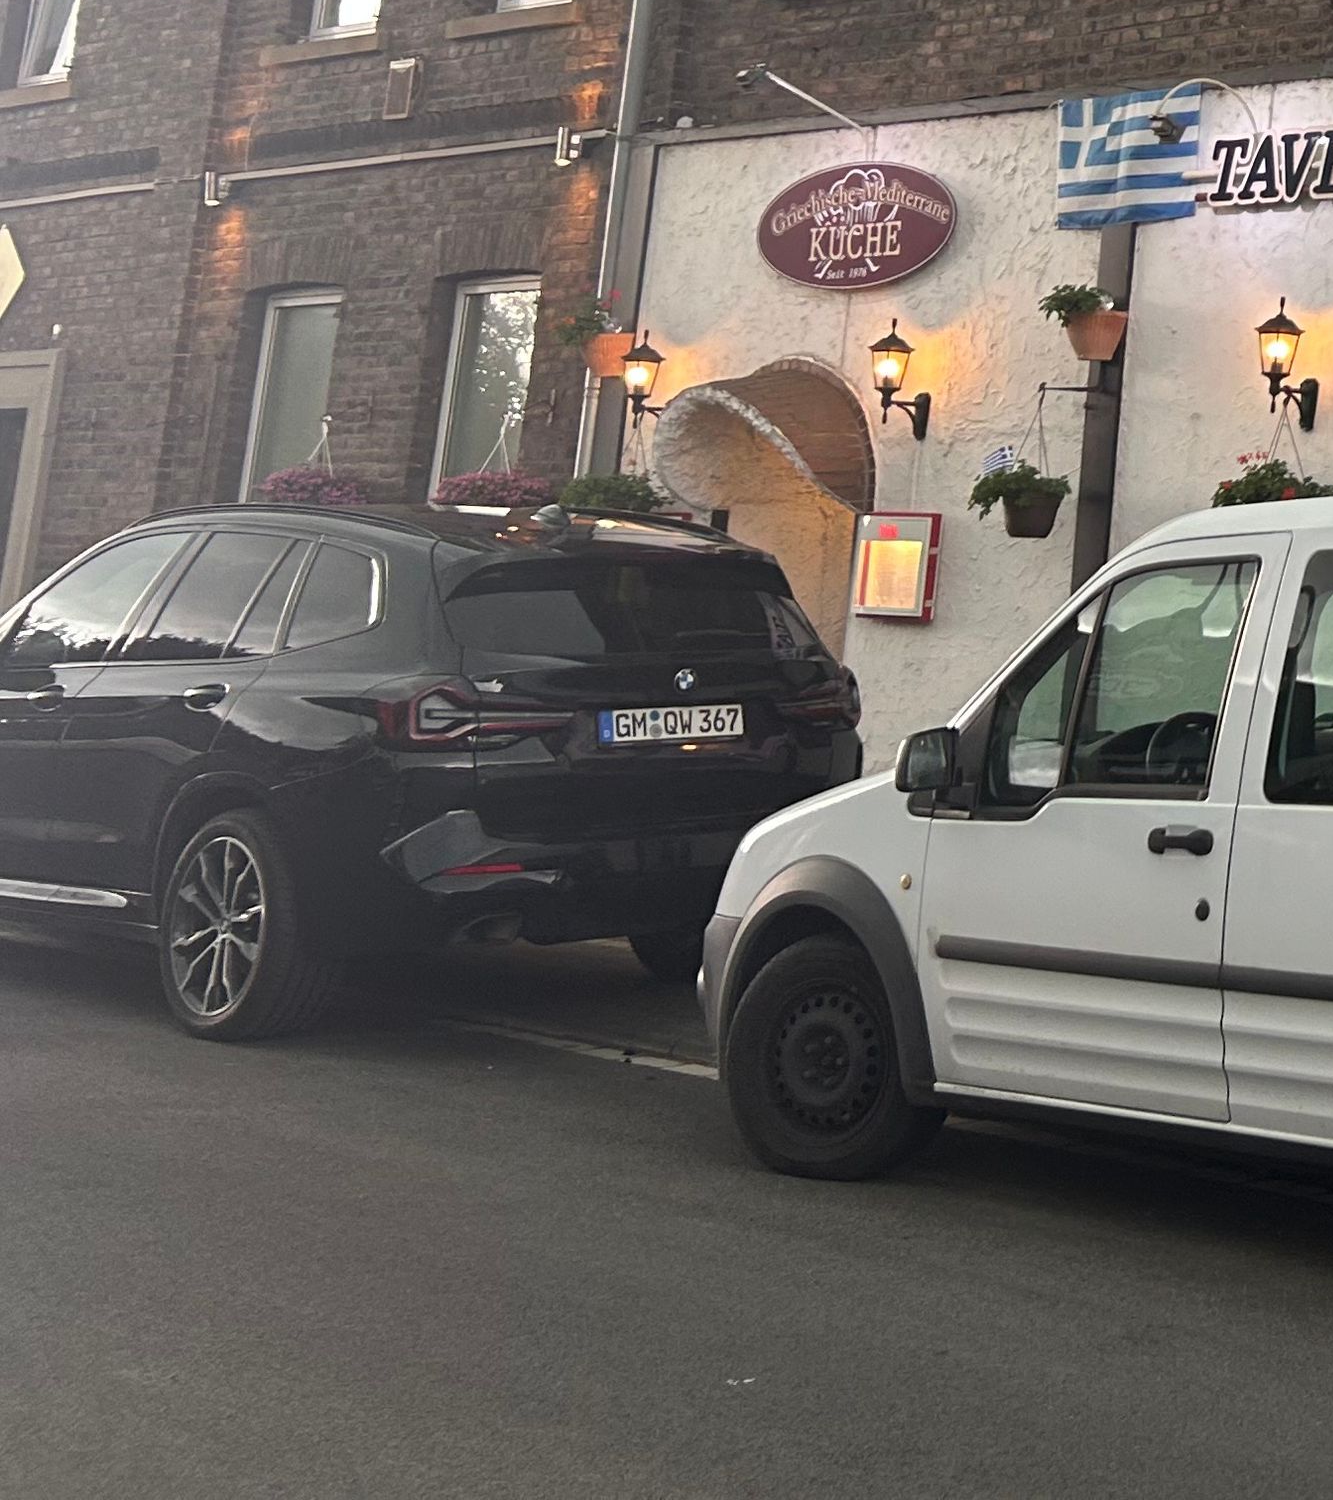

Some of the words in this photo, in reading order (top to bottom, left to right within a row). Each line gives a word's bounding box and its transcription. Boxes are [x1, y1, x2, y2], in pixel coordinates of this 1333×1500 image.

[615, 711, 647, 738] GM
[664, 710, 693, 735] QW
[700, 708, 739, 733] 367
